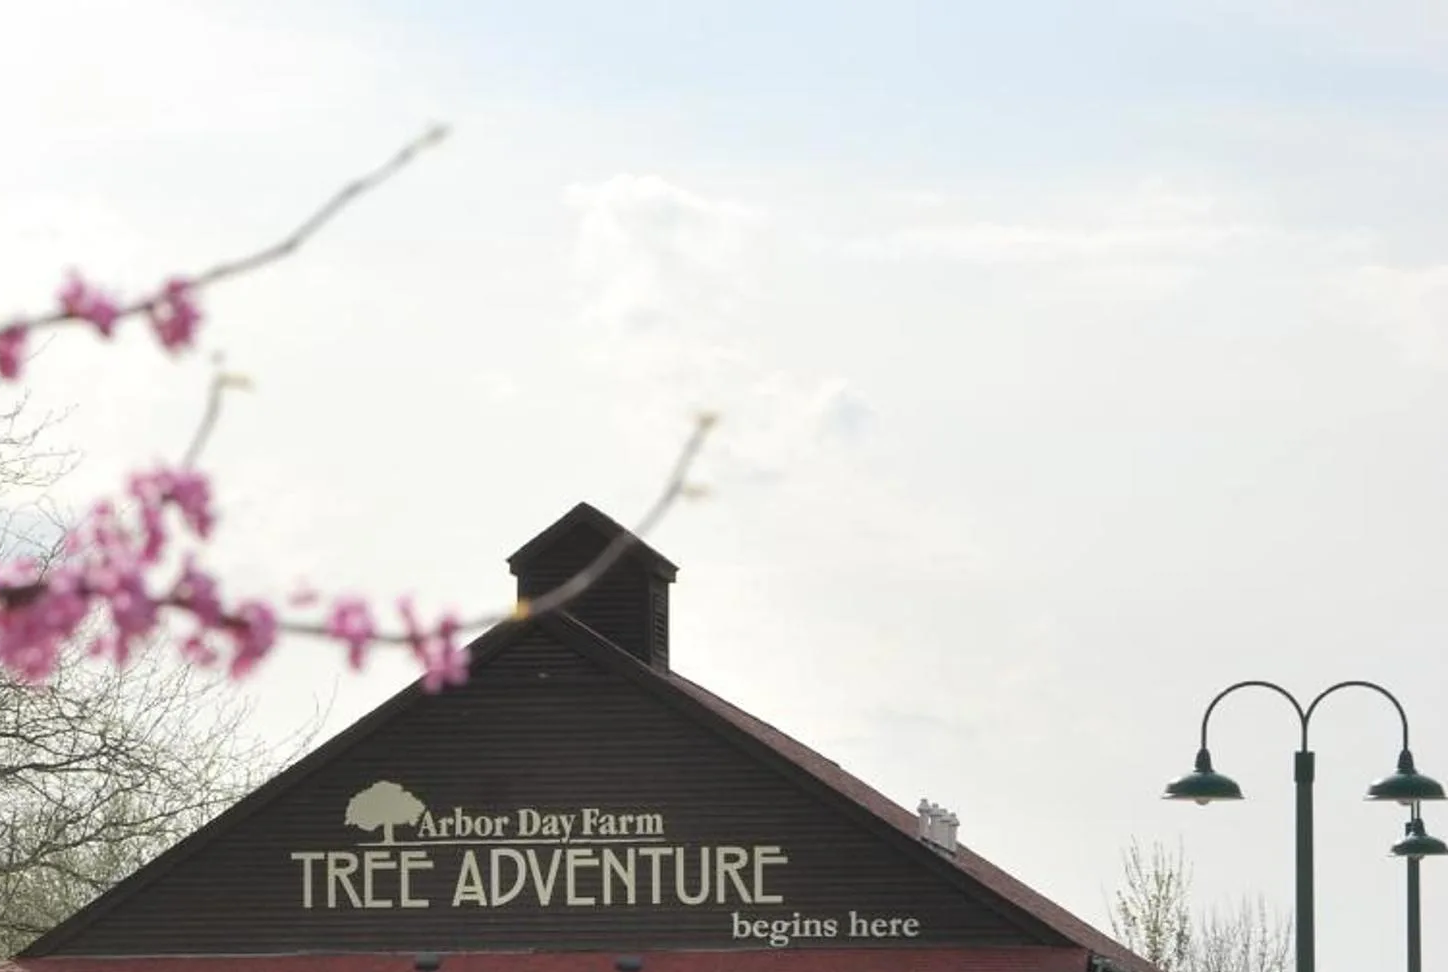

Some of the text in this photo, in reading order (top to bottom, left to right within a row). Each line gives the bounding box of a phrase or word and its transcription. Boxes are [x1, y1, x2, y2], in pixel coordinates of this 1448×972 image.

[418, 808, 664, 844] Arbor Day Farm
[292, 846, 788, 909] TREE ADVENTURE
[732, 911, 920, 947] begins here
